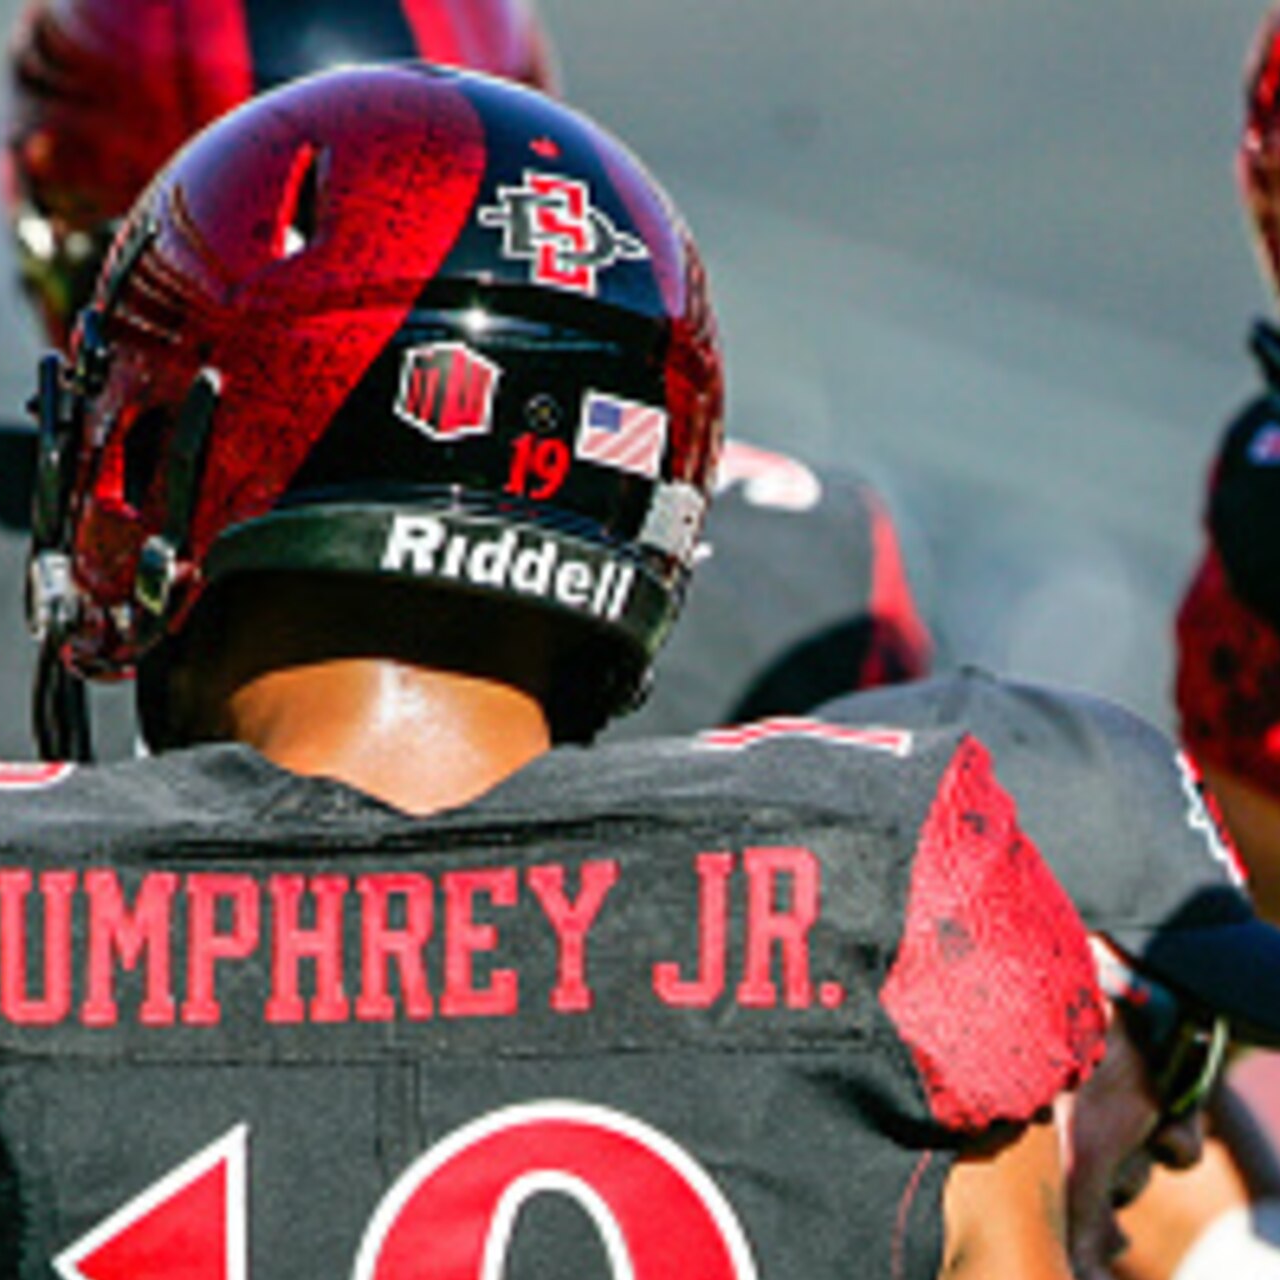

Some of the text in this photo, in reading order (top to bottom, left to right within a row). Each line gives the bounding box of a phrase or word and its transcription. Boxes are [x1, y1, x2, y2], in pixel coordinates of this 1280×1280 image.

[503, 431, 569, 500] 19
[379, 513, 634, 621] Riddell
[651, 845, 846, 1010] JR.
